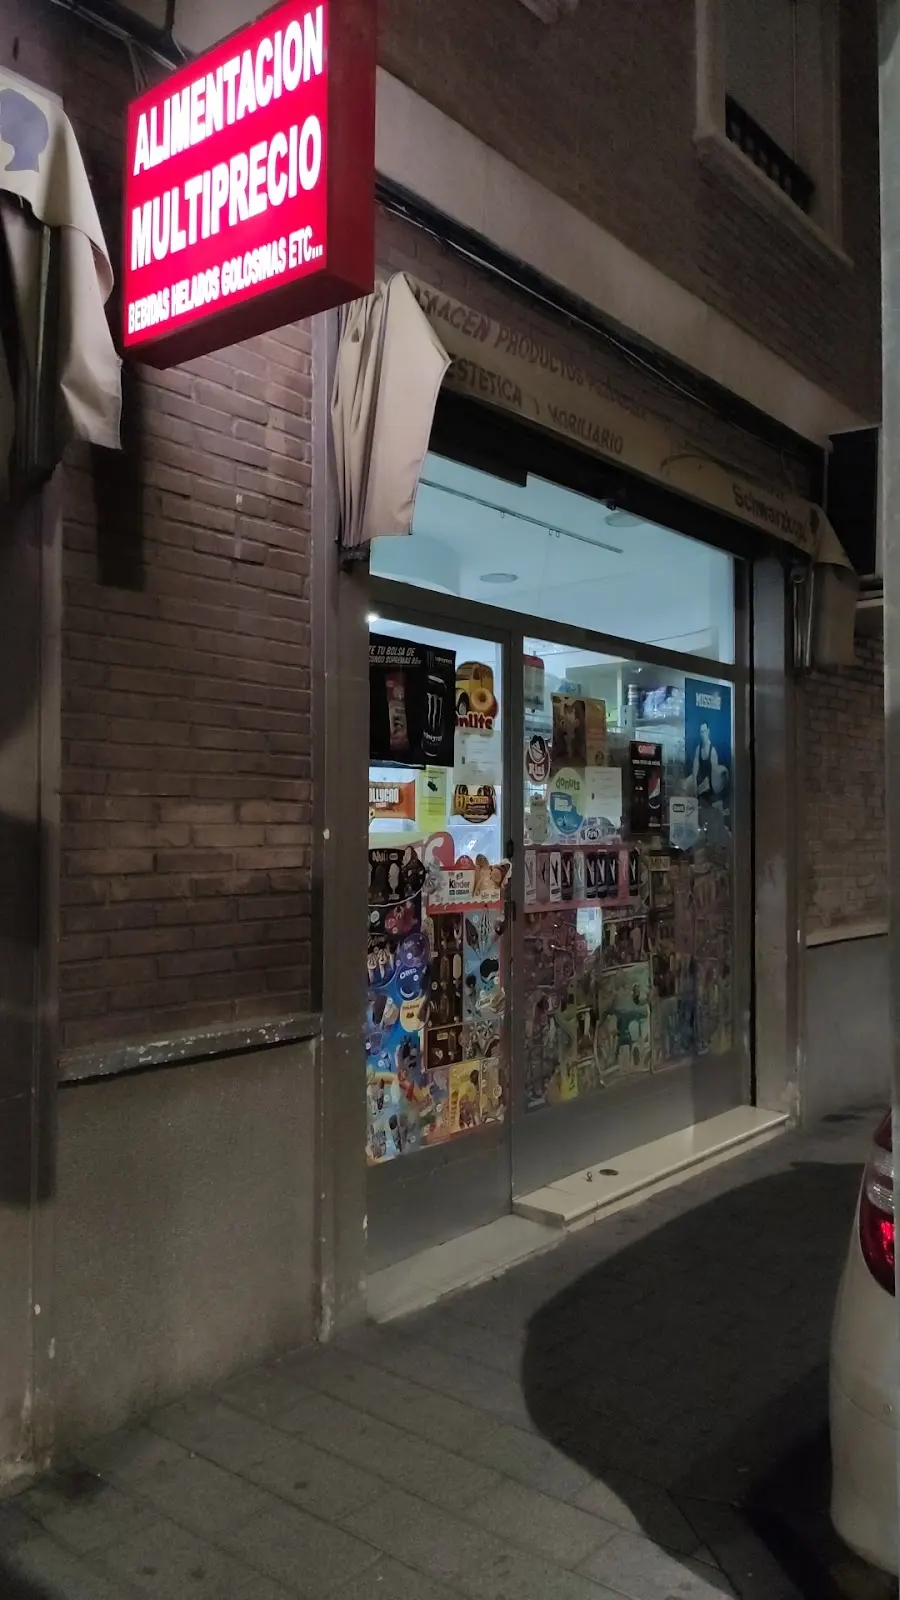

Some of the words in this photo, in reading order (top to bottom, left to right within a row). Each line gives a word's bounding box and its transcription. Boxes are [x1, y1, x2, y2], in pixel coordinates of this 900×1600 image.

[133, 5, 323, 176] ALIMENTACION
[131, 115, 322, 271] MULTIPRECIO
[128, 287, 170, 335] BEBIDAS
[171, 265, 220, 317] HELADOS
[221, 236, 287, 296] GOLOSINAS
[288, 225, 323, 269] ETC...
[446, 352, 522, 408] ESTETICA
[494, 326, 584, 385] PRODUCTOS
